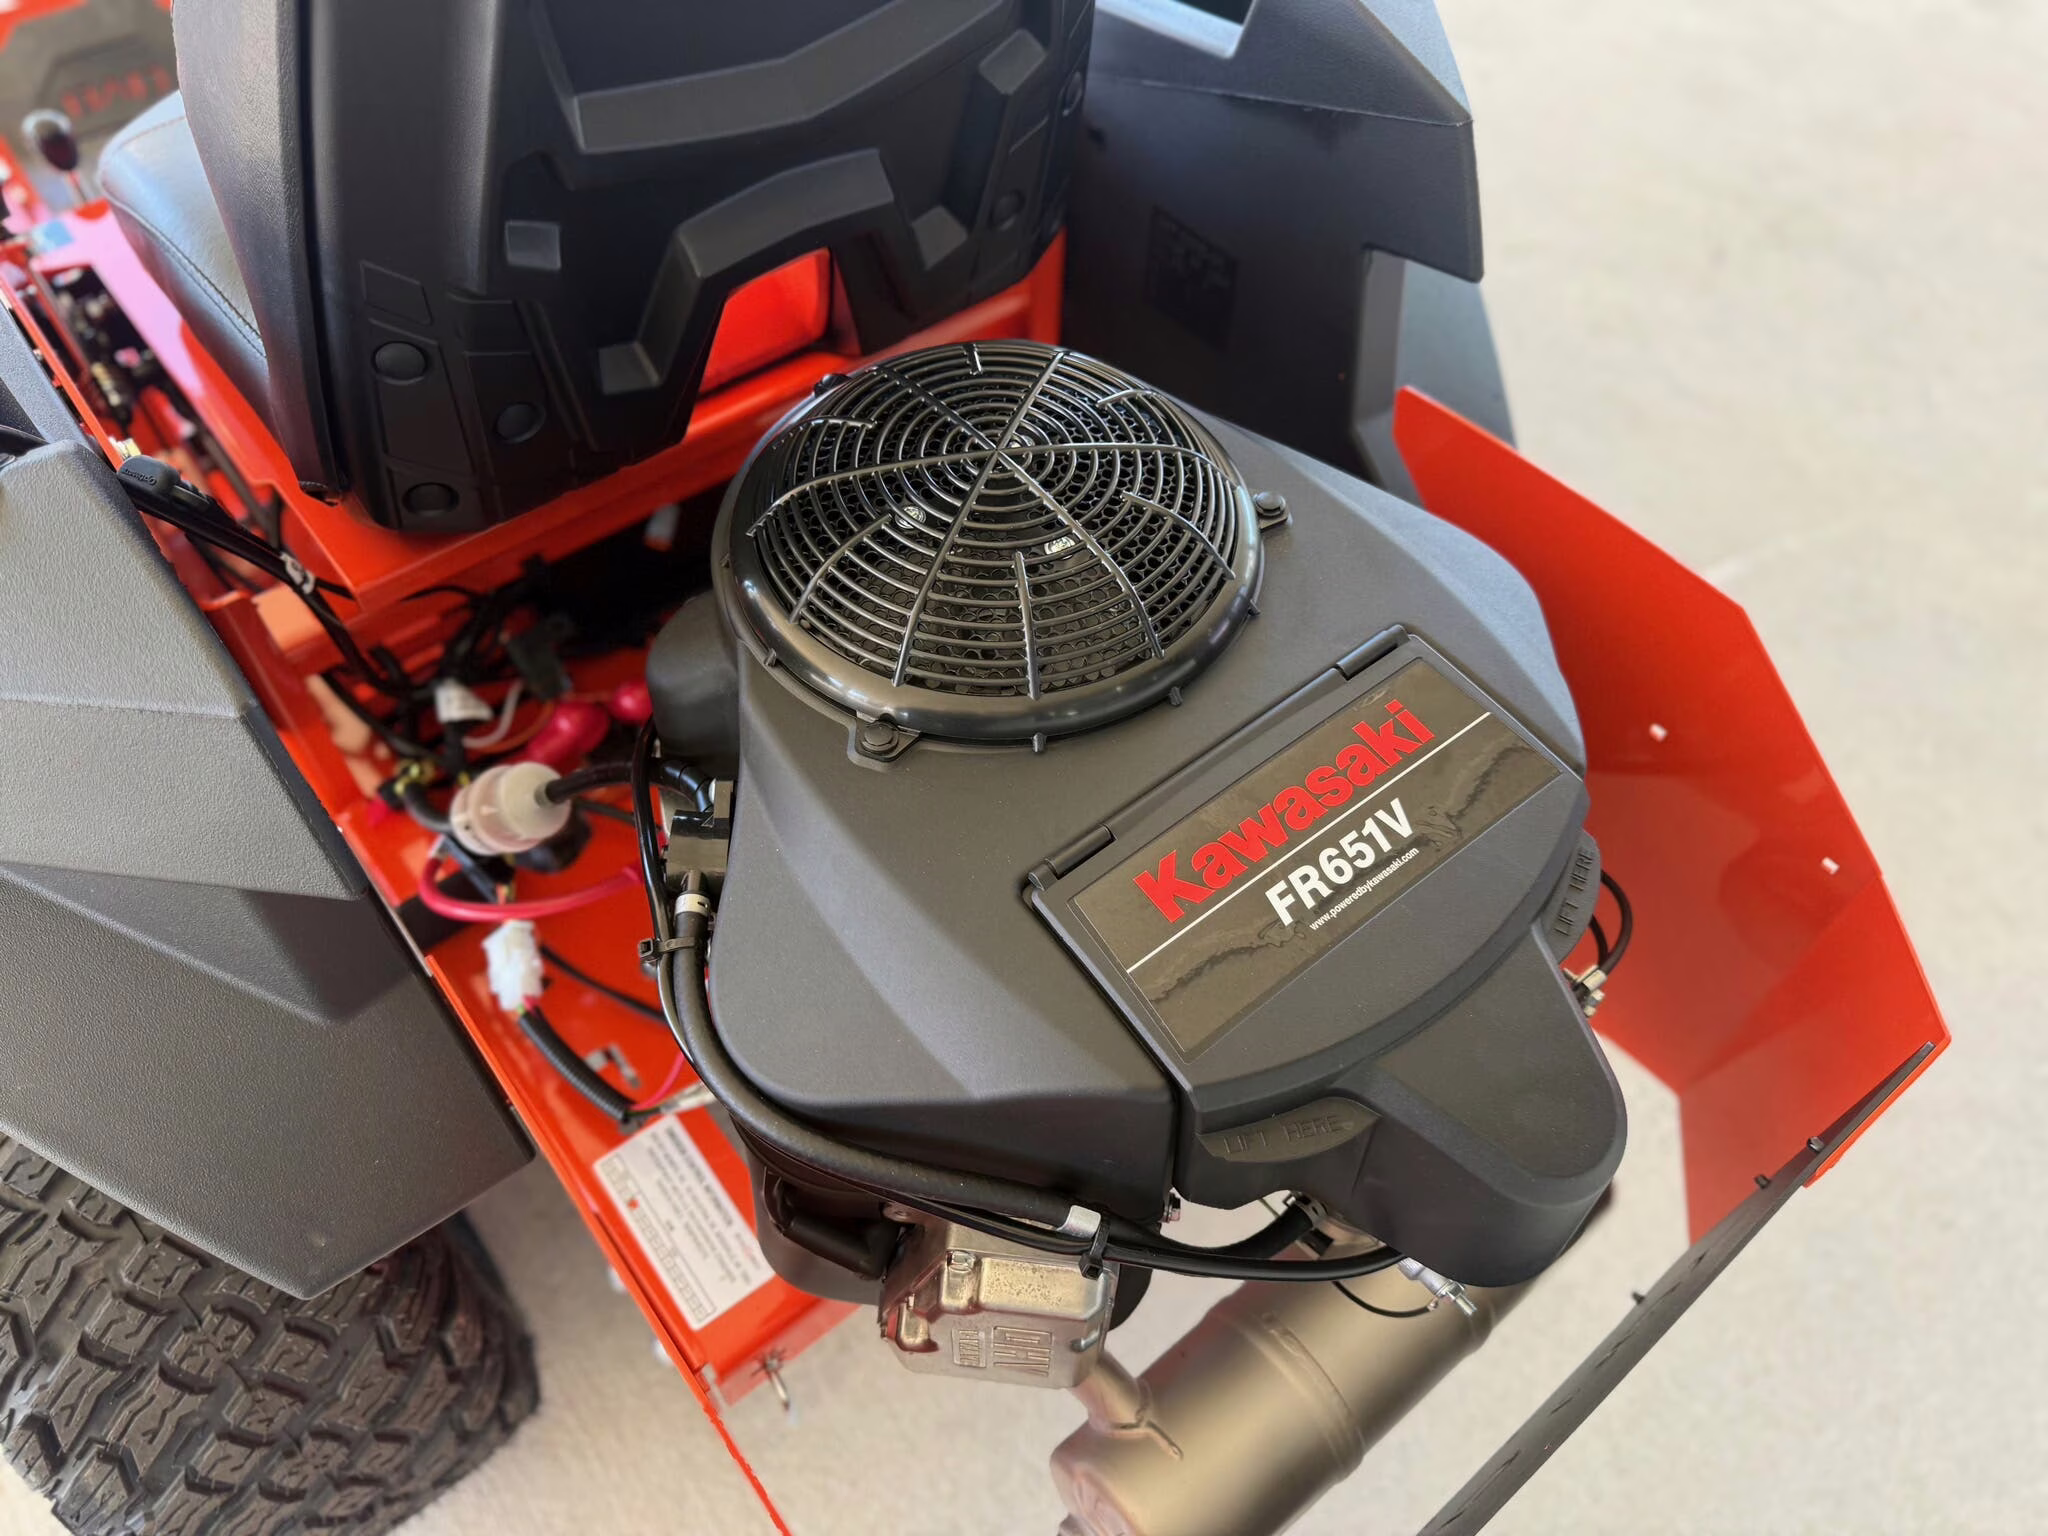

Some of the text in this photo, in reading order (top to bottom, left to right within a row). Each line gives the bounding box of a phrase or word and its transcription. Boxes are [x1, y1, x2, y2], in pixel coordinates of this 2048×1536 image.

[1133, 699, 1436, 923] Kawasaki
[1265, 797, 1413, 926] FR651V
[1309, 848, 1419, 930] www.poweredbykawasaki.com
[1552, 848, 1594, 937] LIFT HERE
[1223, 1115, 1340, 1153] LIFT HERE
